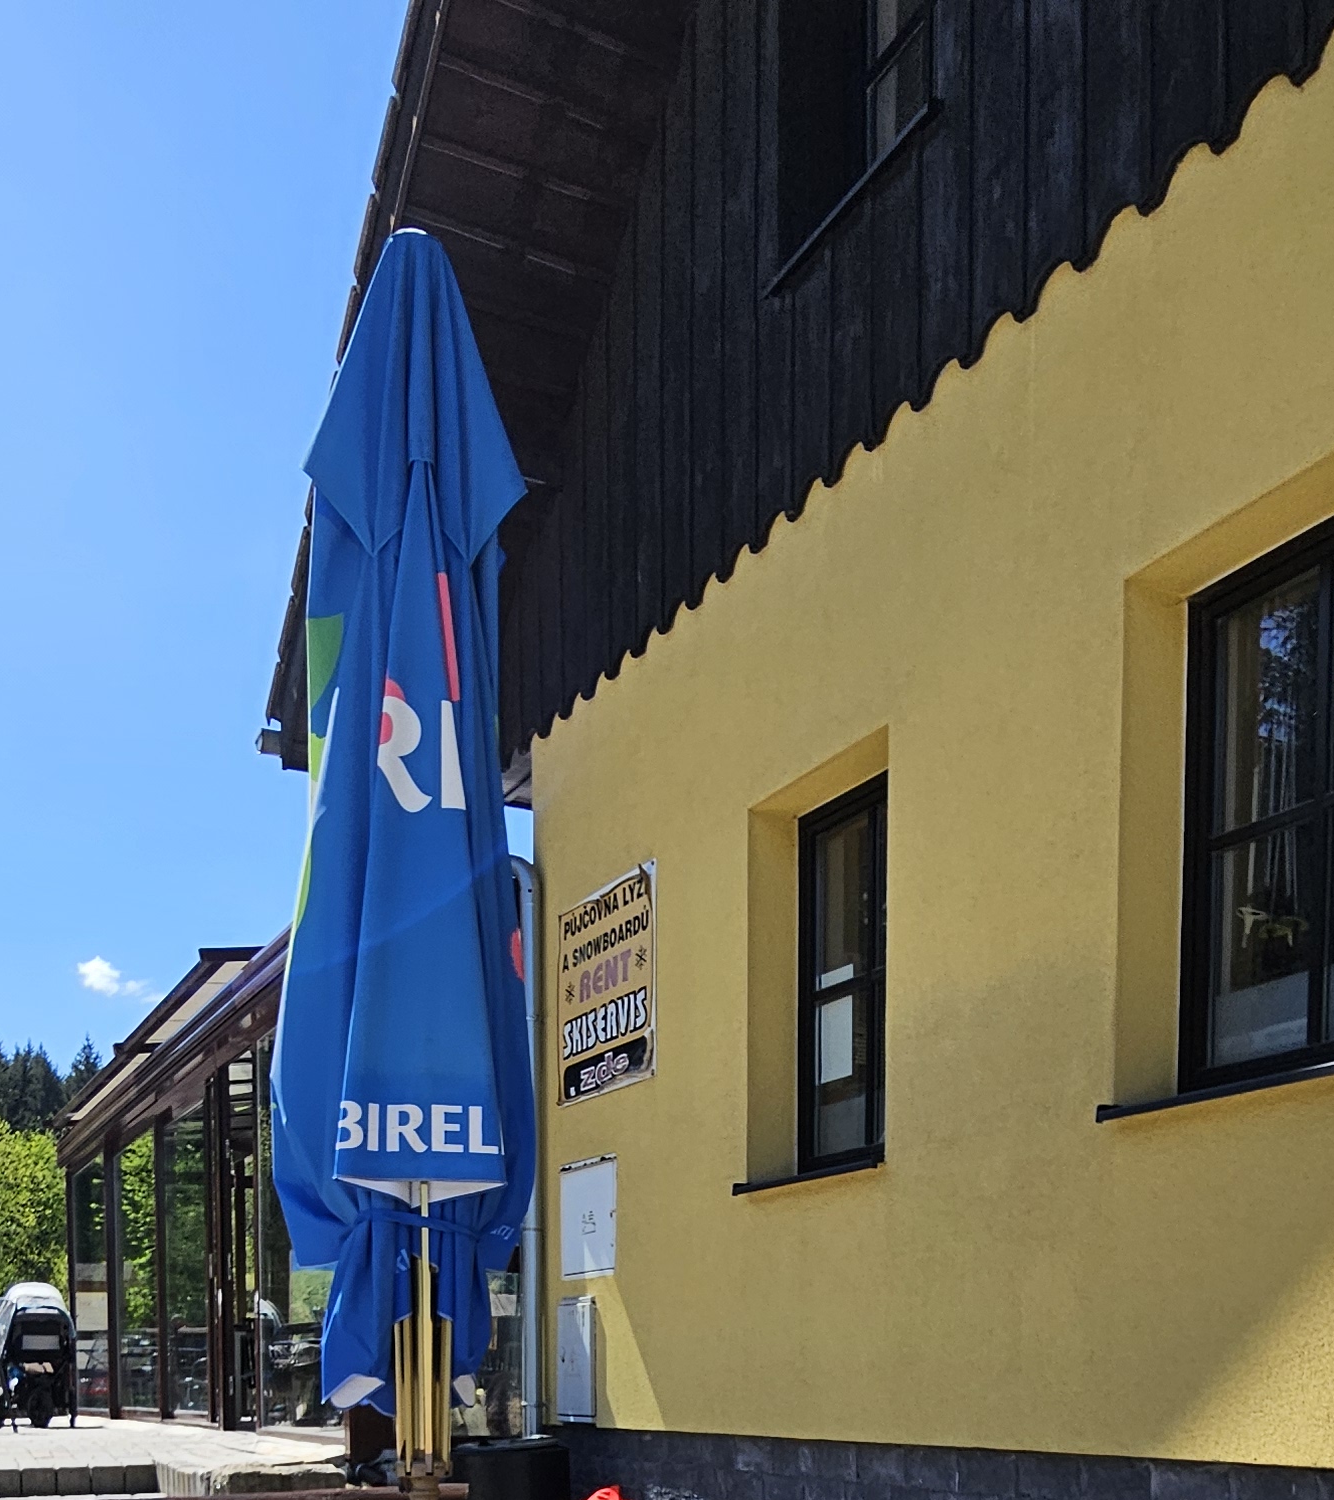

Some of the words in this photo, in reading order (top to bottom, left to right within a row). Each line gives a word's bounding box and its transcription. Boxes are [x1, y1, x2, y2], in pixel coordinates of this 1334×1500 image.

[562, 953, 570, 973] A
[572, 905, 649, 968] SNOWBOARDŮ
[580, 949, 632, 1004] RENT
[563, 987, 647, 1060] SKISERVIS
[580, 1051, 630, 1091] zde
